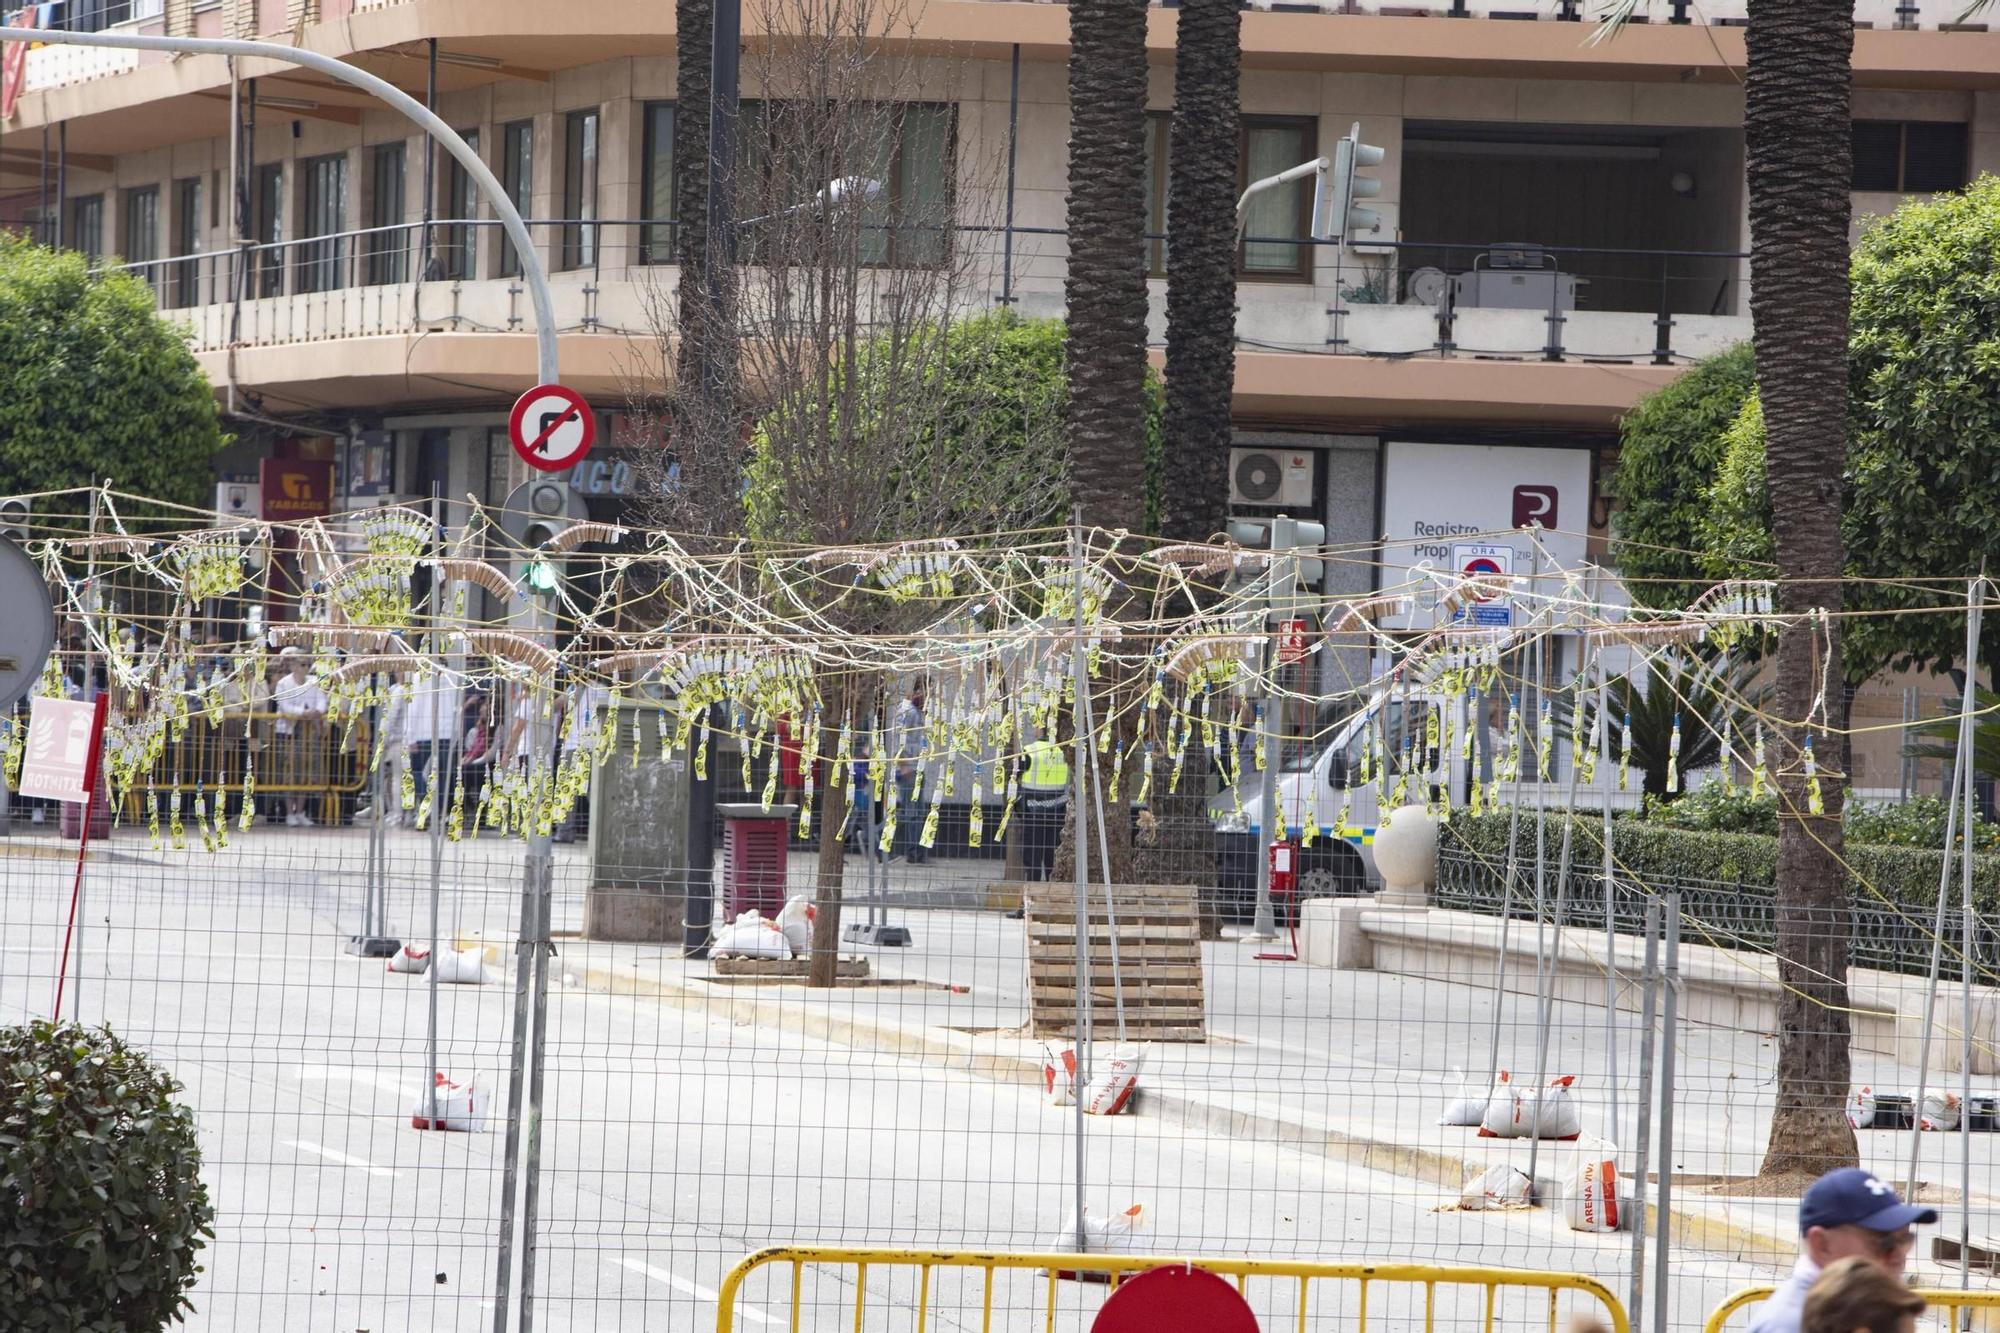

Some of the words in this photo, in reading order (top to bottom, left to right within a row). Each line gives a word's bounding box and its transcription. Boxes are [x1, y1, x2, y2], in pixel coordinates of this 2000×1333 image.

[1414, 521, 1480, 540] Registro
[1471, 547, 1496, 555] ORA
[1584, 1185, 1595, 1224] ARENA
